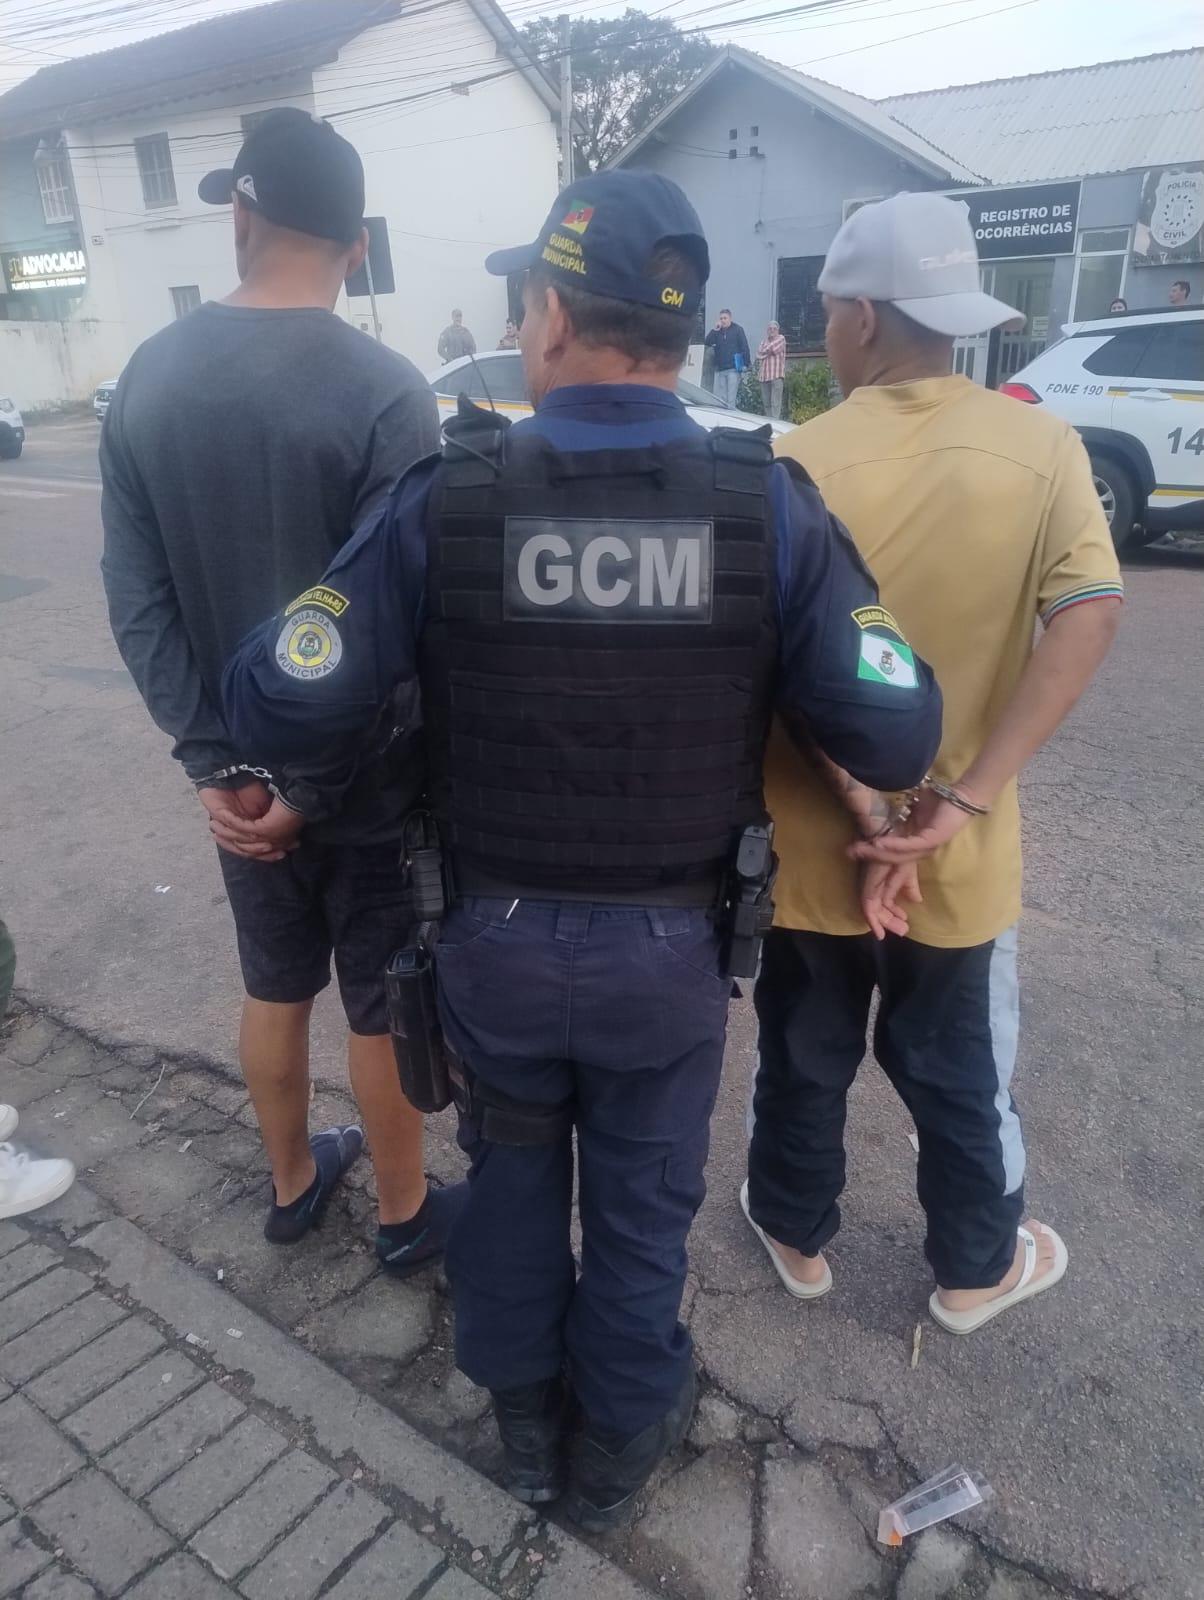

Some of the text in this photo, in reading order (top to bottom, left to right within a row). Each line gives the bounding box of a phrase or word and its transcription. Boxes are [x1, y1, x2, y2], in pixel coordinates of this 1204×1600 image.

[980, 204, 1071, 223] REGISTRO DE
[975, 221, 1073, 239] OCORRÊNCIAS
[1163, 230, 1186, 239] CIVIL
[549, 233, 583, 256] GUARDA
[22, 250, 86, 276] ADVOCACIA
[541, 247, 587, 275] MUNICIPAL
[661, 287, 684, 308] GM
[1045, 383, 1104, 396] FONE 190
[517, 534, 700, 608] GCM
[291, 611, 330, 628] GUARDA
[277, 652, 337, 678] MUNICIPAL
